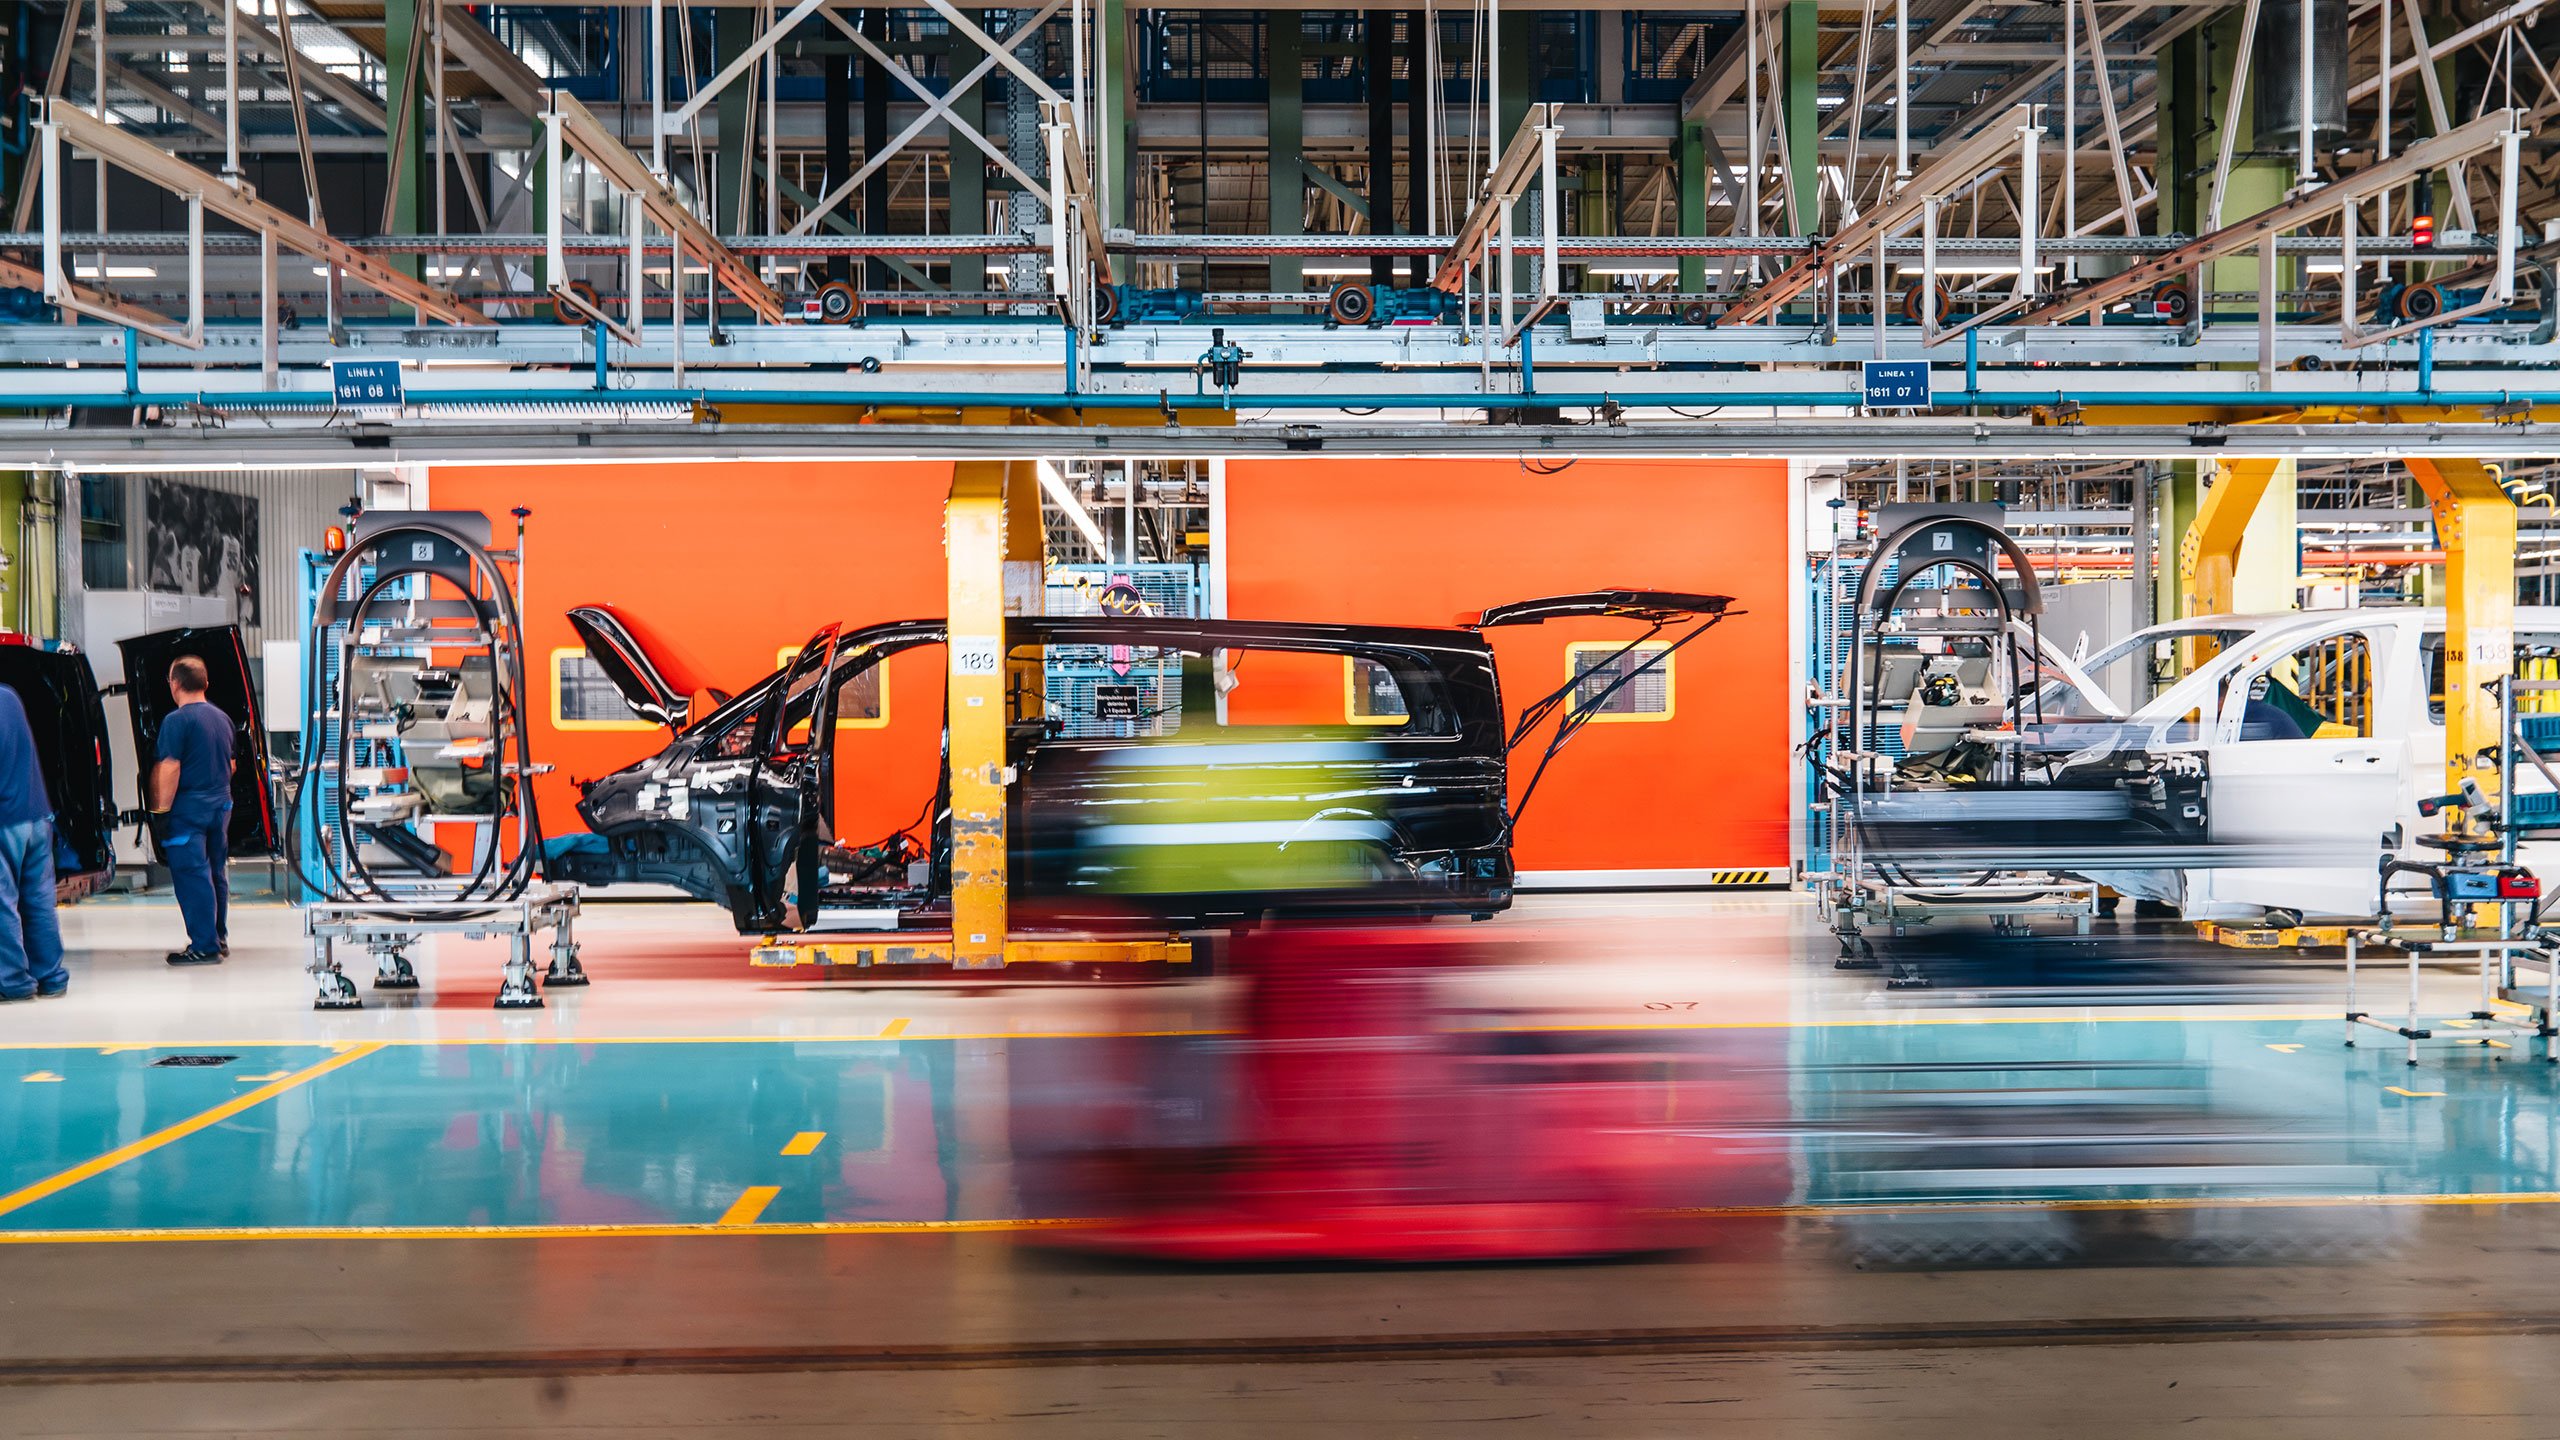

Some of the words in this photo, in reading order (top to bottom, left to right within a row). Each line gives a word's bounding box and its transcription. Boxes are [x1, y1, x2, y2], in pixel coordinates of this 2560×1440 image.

[347, 367, 376, 377] LINEA
[339, 384, 361, 398] 1611
[368, 383, 384, 397] 08
[1869, 387, 1890, 397] 1611
[1897, 387, 1911, 397] 07
[1938, 535, 1946, 548] 7
[418, 545, 427, 558] 8
[2446, 650, 2464, 662] 138
[2476, 643, 2507, 660] 138
[961, 652, 994, 670] 189
[1643, 1002, 1699, 1011] 07
